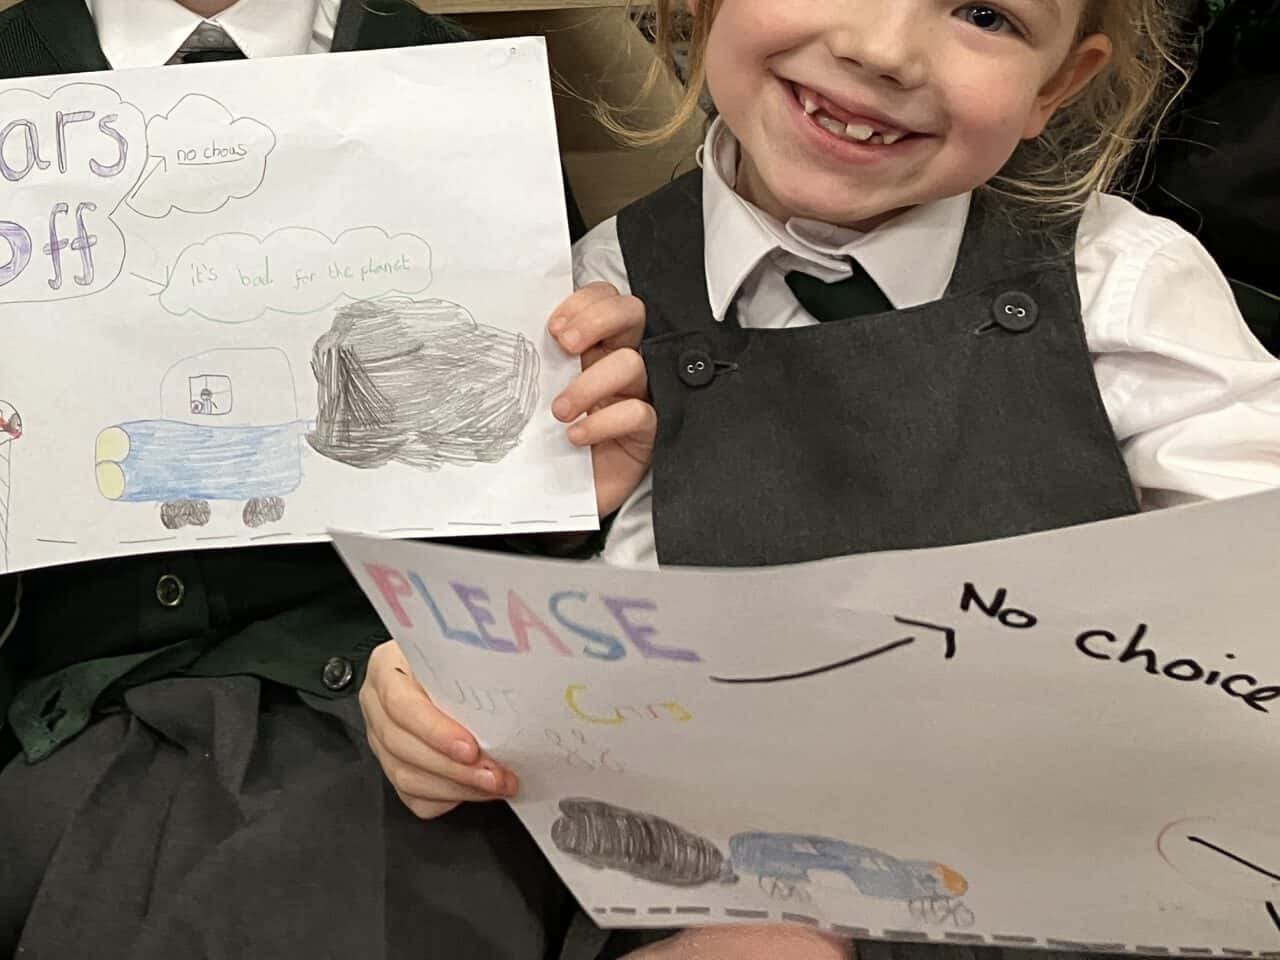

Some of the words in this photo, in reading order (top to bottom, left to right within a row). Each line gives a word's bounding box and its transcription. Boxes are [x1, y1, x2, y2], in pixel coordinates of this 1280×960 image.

[176, 146, 197, 162] no
[237, 255, 274, 287] bad
[293, 269, 318, 289] for
[327, 259, 353, 280] the
[359, 253, 412, 283] planet
[363, 560, 703, 663] PLEASE
[959, 581, 1038, 629] No
